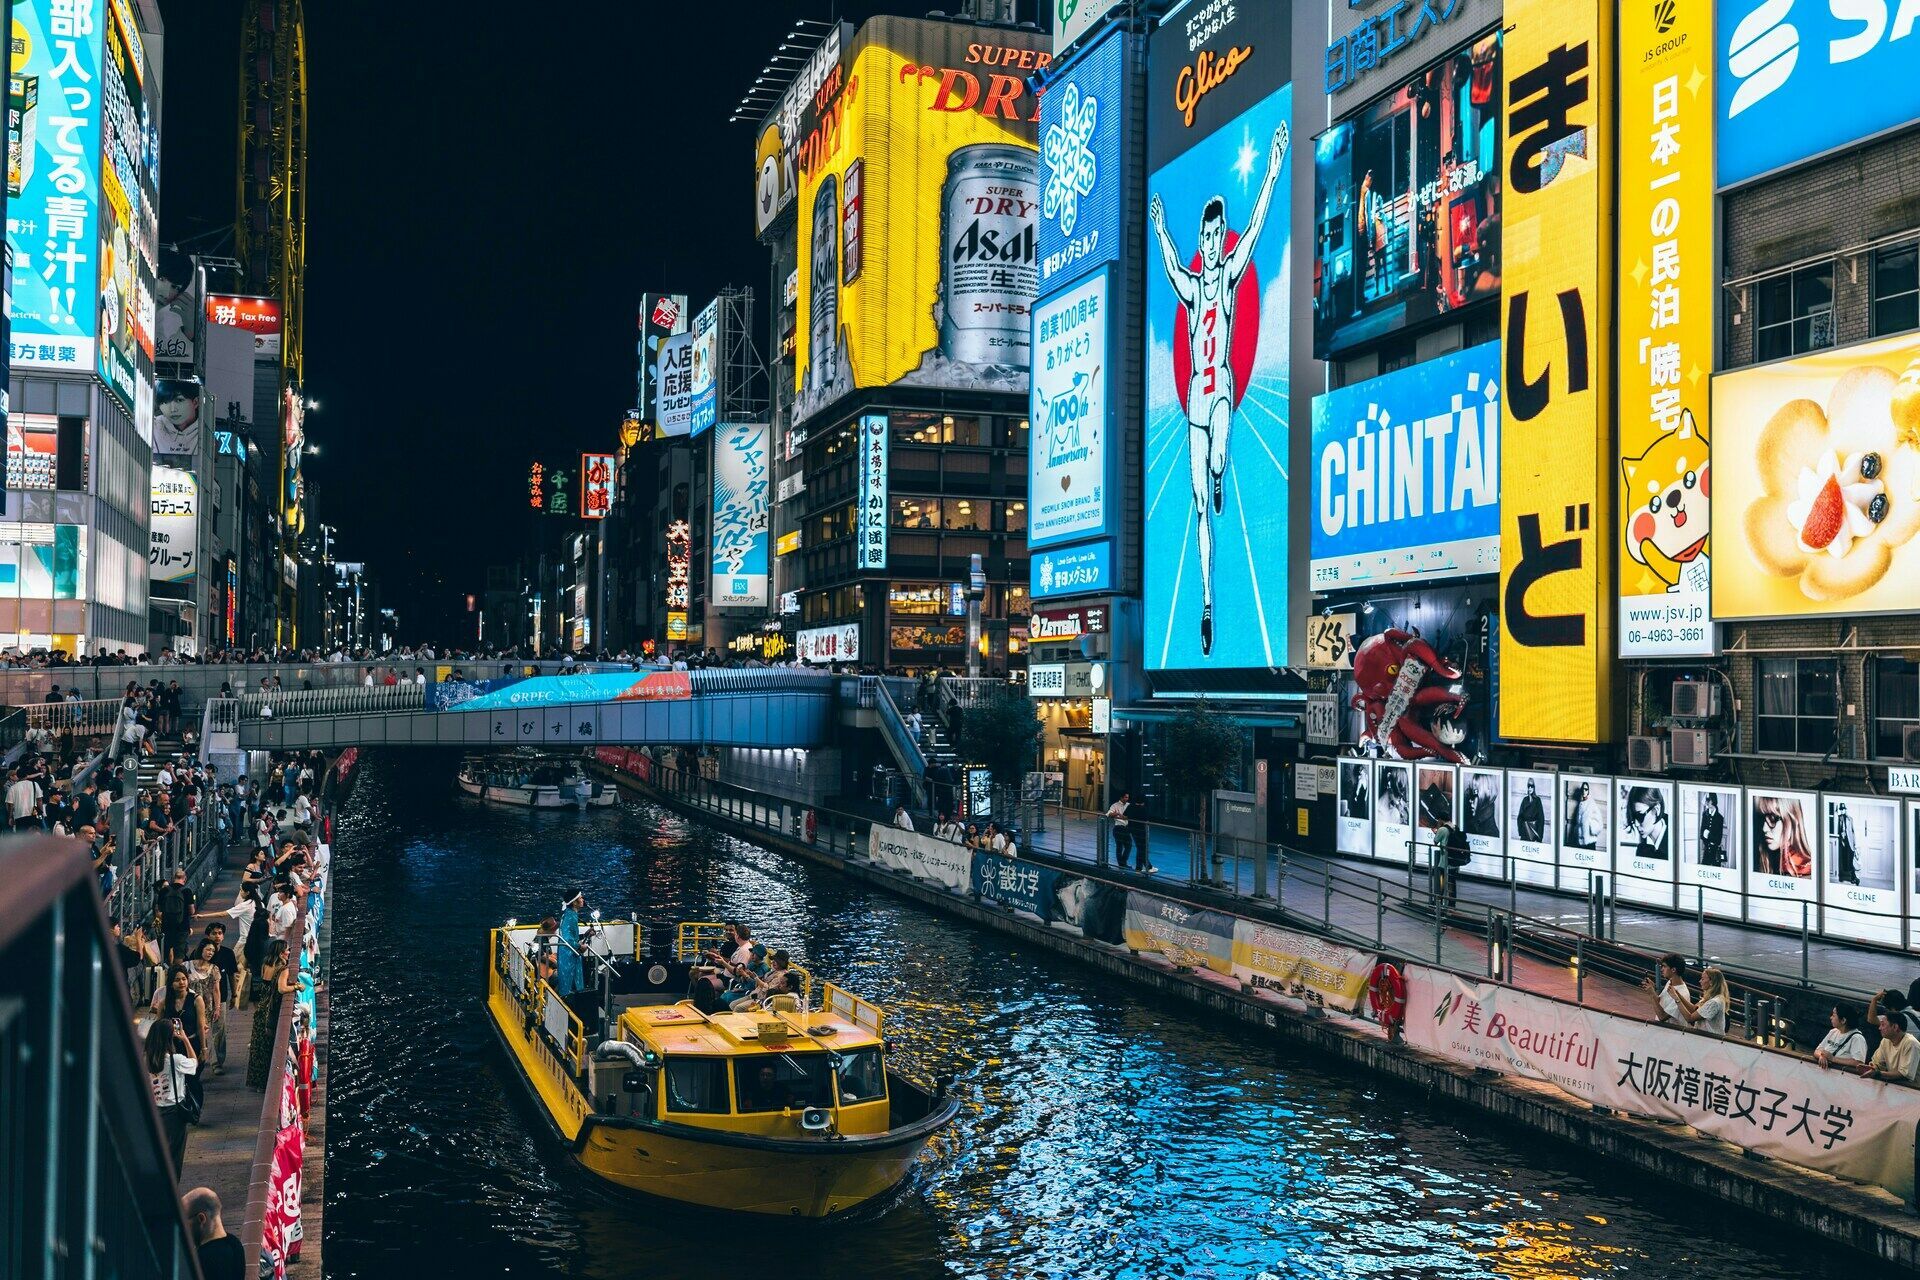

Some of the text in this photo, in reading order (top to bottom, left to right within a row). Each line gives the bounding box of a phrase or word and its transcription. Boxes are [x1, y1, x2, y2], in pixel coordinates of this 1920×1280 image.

[1190, 5, 1235, 51] ゆたかな人生
[966, 44, 1053, 71] SUPER
[1643, 49, 1654, 63] JS
[1655, 33, 1688, 56] GROUP
[1175, 46, 1251, 127] Glico
[986, 186, 1023, 198] SUPER
[1650, 74, 1681, 331] 日本一の民泊
[953, 217, 1038, 263] Asah
[990, 269, 1016, 289] 生
[215, 305, 237, 326] 税
[241, 312, 277, 323] Tax Free
[1040, 294, 1099, 344] 創業100周年
[1047, 332, 1090, 371] ありがとう
[1203, 302, 1217, 395] グリコ
[1504, 39, 1591, 648] まいど
[664, 345, 692, 373] 入店
[663, 371, 692, 396] 応援
[1320, 398, 1498, 537] CHINTAI
[1629, 606, 1703, 623] www.jsv.jp
[1628, 627, 1704, 643] 06-4963-3661
[494, 721, 593, 737] えびす橋
[1347, 821, 1362, 829] CELINE
[1472, 839, 1489, 847] CELINE
[1522, 845, 1540, 854] CELINE
[1575, 852, 1594, 862] CELINE
[1633, 861, 1655, 871] CELINE
[1697, 869, 1721, 880] CELINE
[1768, 879, 1795, 891] CELINE
[1847, 891, 1876, 902] CELINE
[1461, 1001, 1482, 1034] 美
[1486, 1012, 1599, 1070] Beautiful
[1475, 1047, 1501, 1062] SHOIN
[1547, 1071, 1595, 1093] UNIVERSITY
[1617, 1052, 1854, 1150] 大阪樟蔭女子大学
